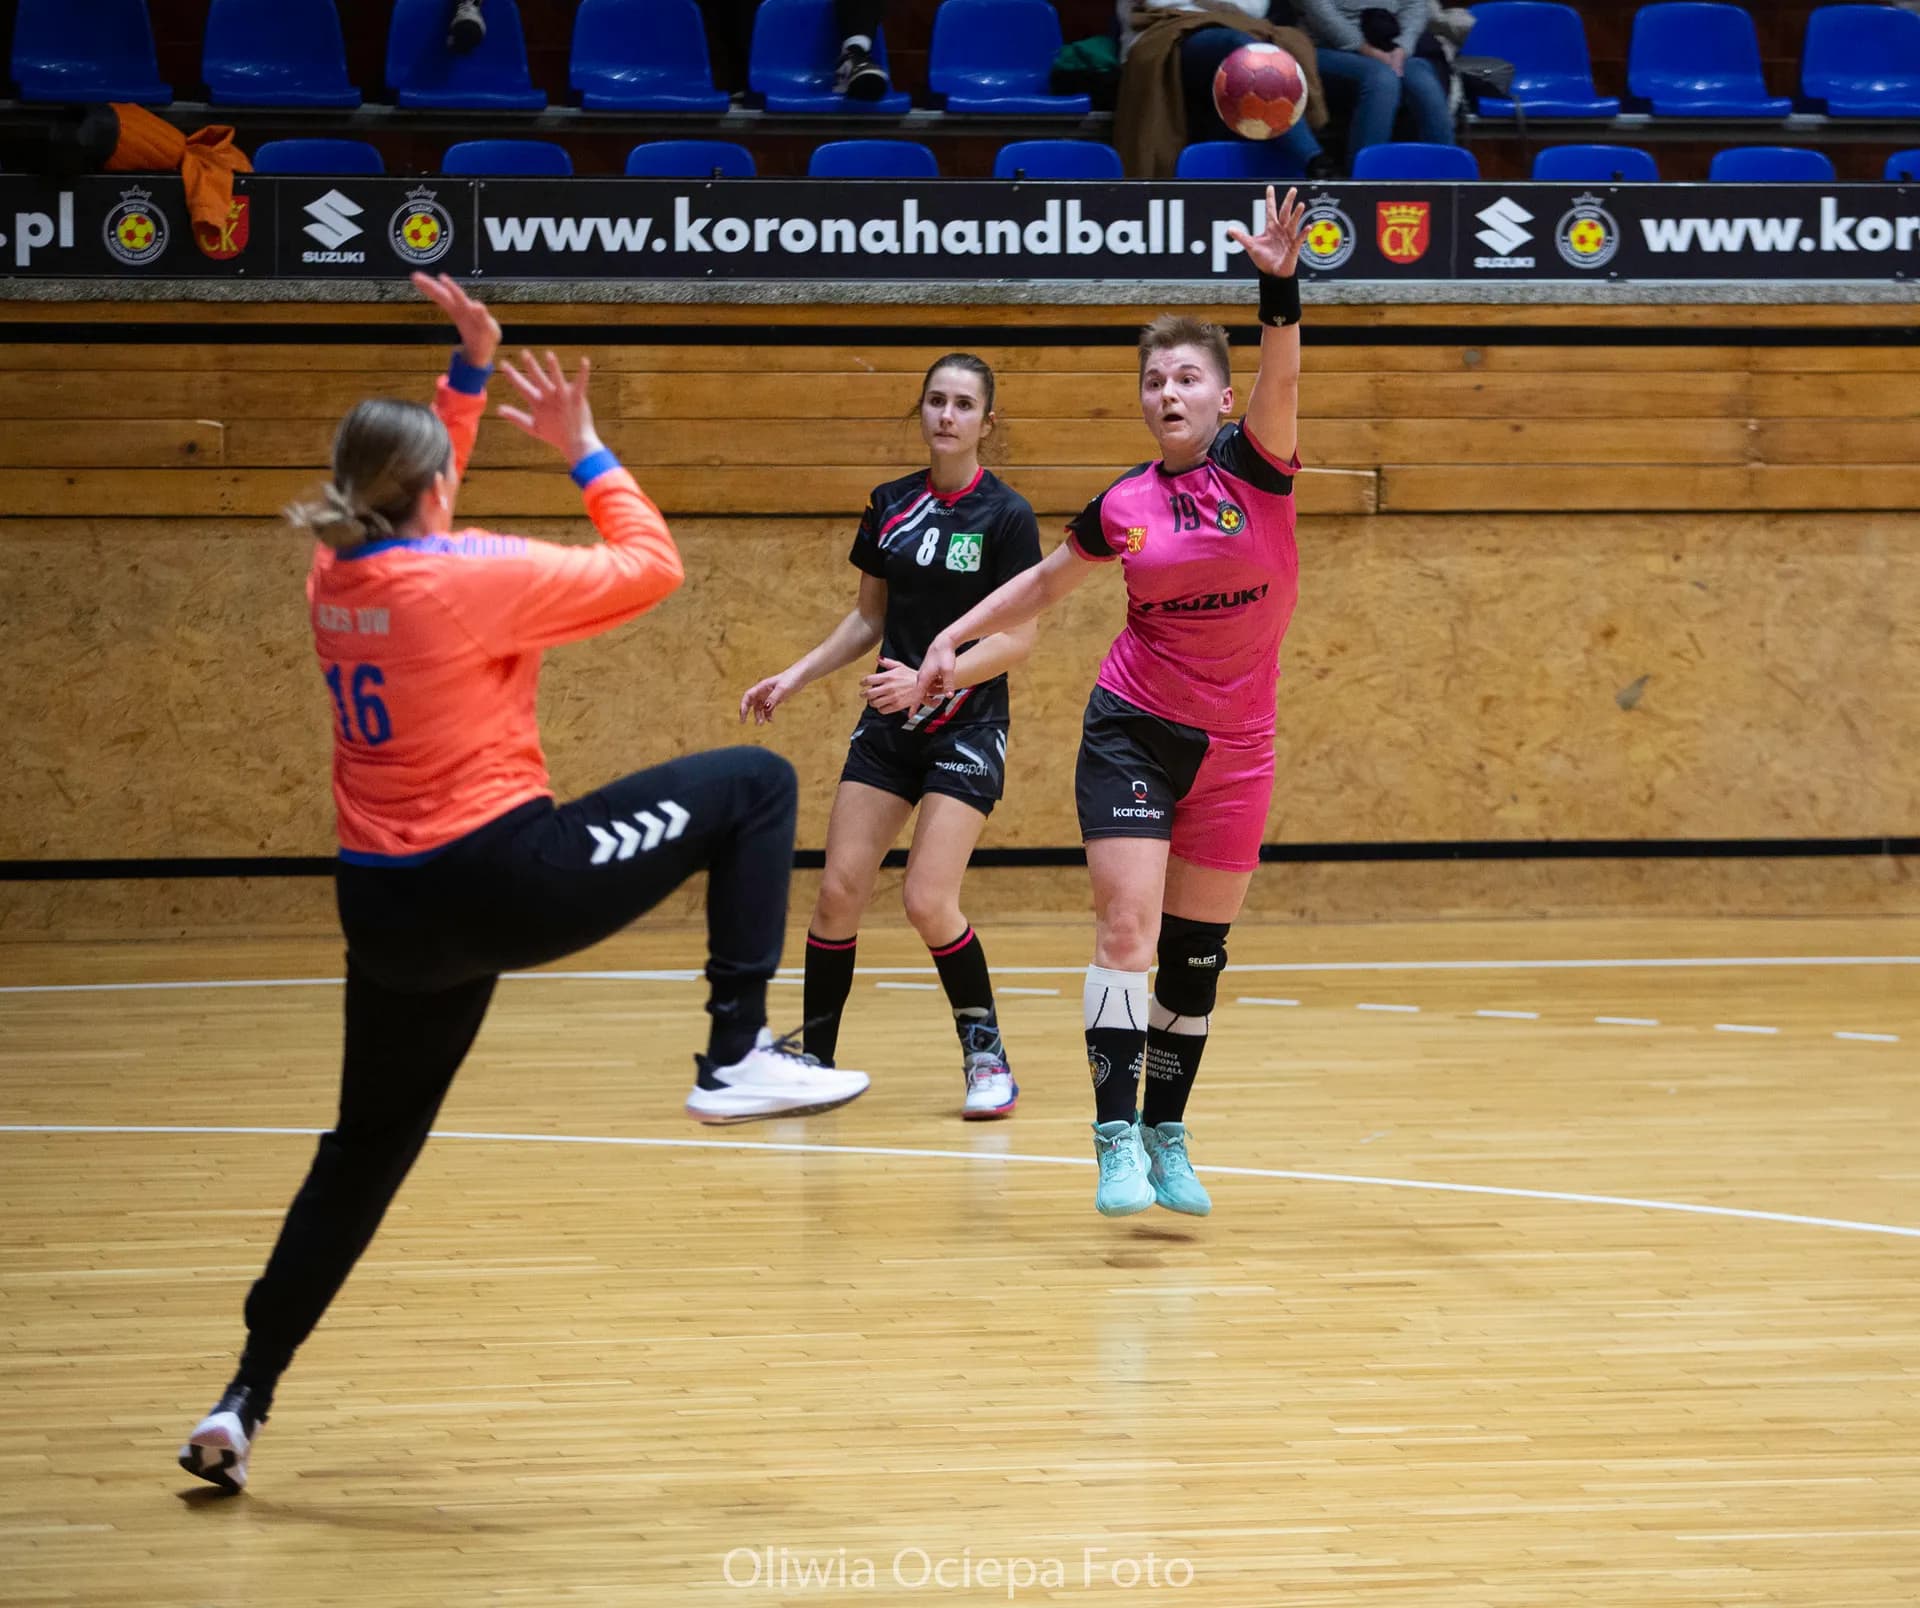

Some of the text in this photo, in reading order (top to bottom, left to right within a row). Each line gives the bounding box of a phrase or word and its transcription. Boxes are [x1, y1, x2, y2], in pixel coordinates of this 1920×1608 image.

[484, 197, 1267, 273] www.koronahandball.pl
[1382, 226, 1420, 257] CK
[1640, 197, 1920, 252] www.kor
[302, 251, 365, 264] SUZUKI
[1169, 493, 1201, 533] 19
[916, 527, 940, 566] 8
[326, 663, 393, 746] 16
[1188, 954, 1217, 965] SELECT
